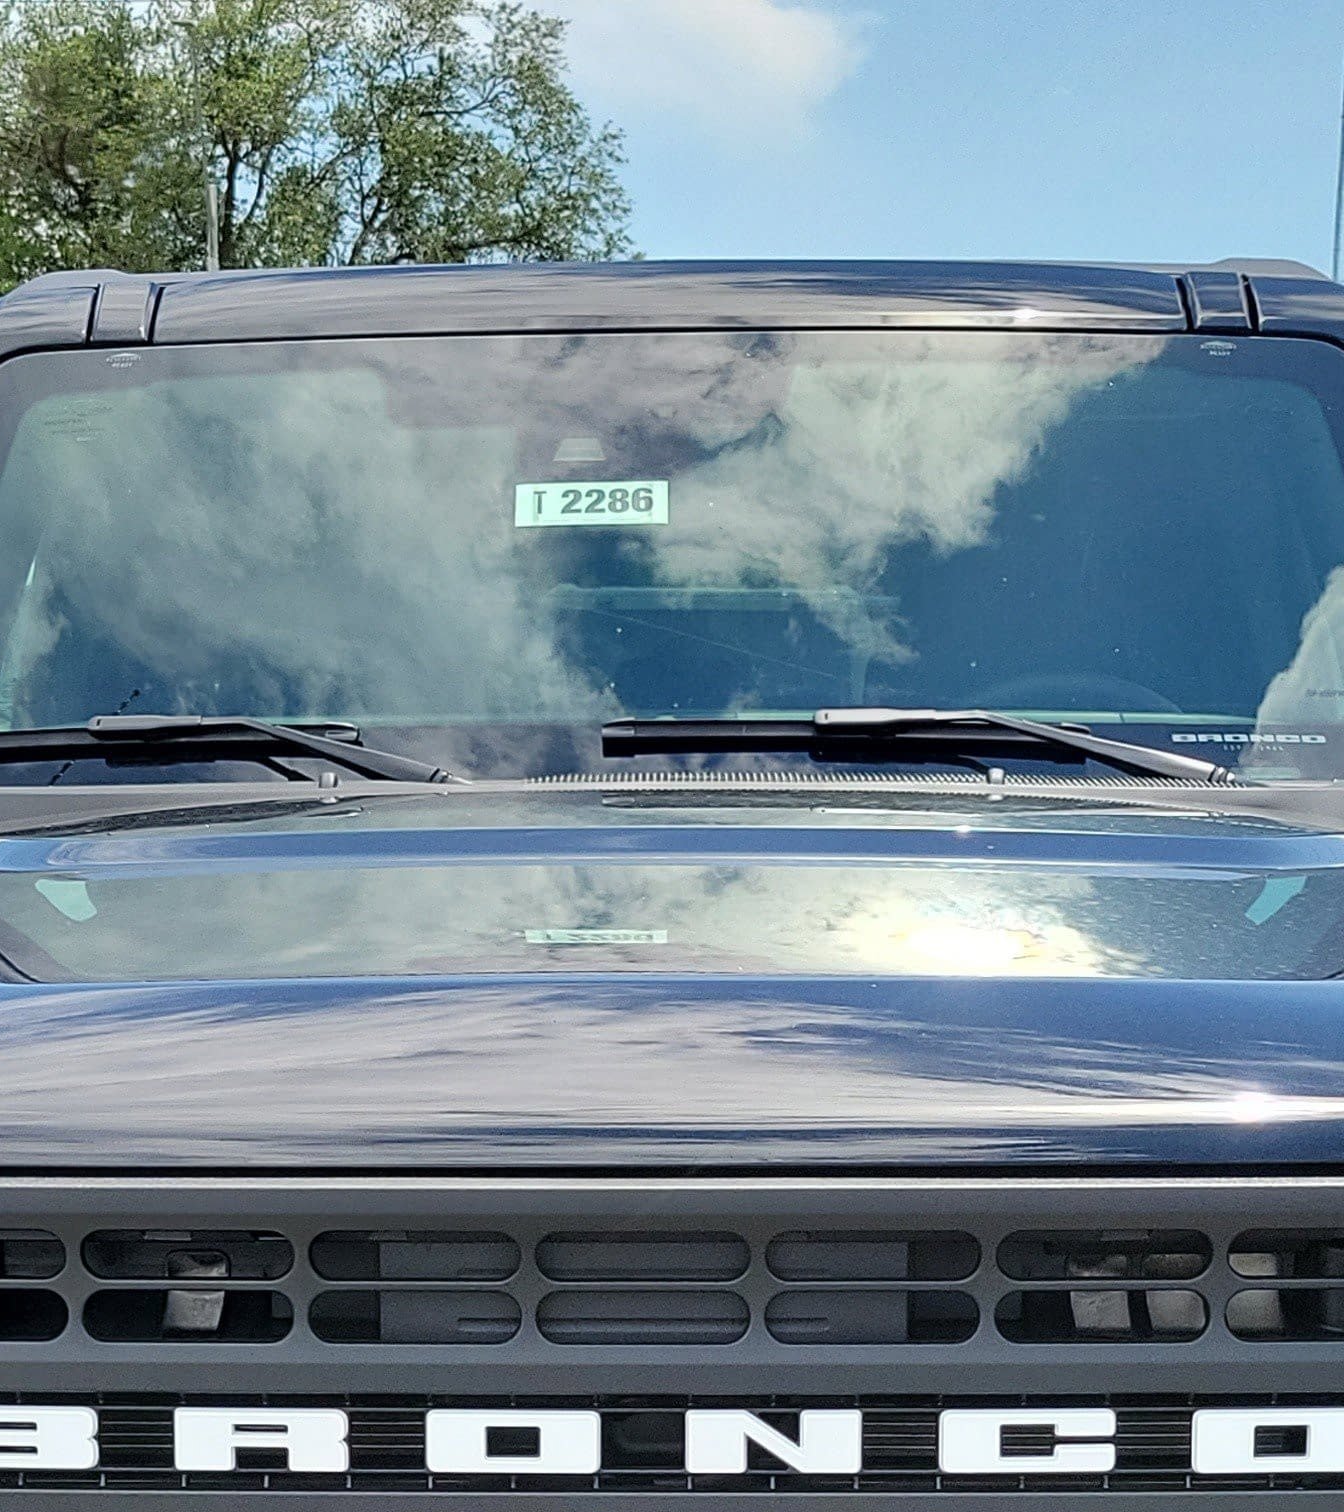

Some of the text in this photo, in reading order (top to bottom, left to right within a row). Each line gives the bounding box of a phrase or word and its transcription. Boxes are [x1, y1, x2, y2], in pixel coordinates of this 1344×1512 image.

[533, 487, 654, 515] T 2286
[1171, 733, 1327, 744] BRONCO
